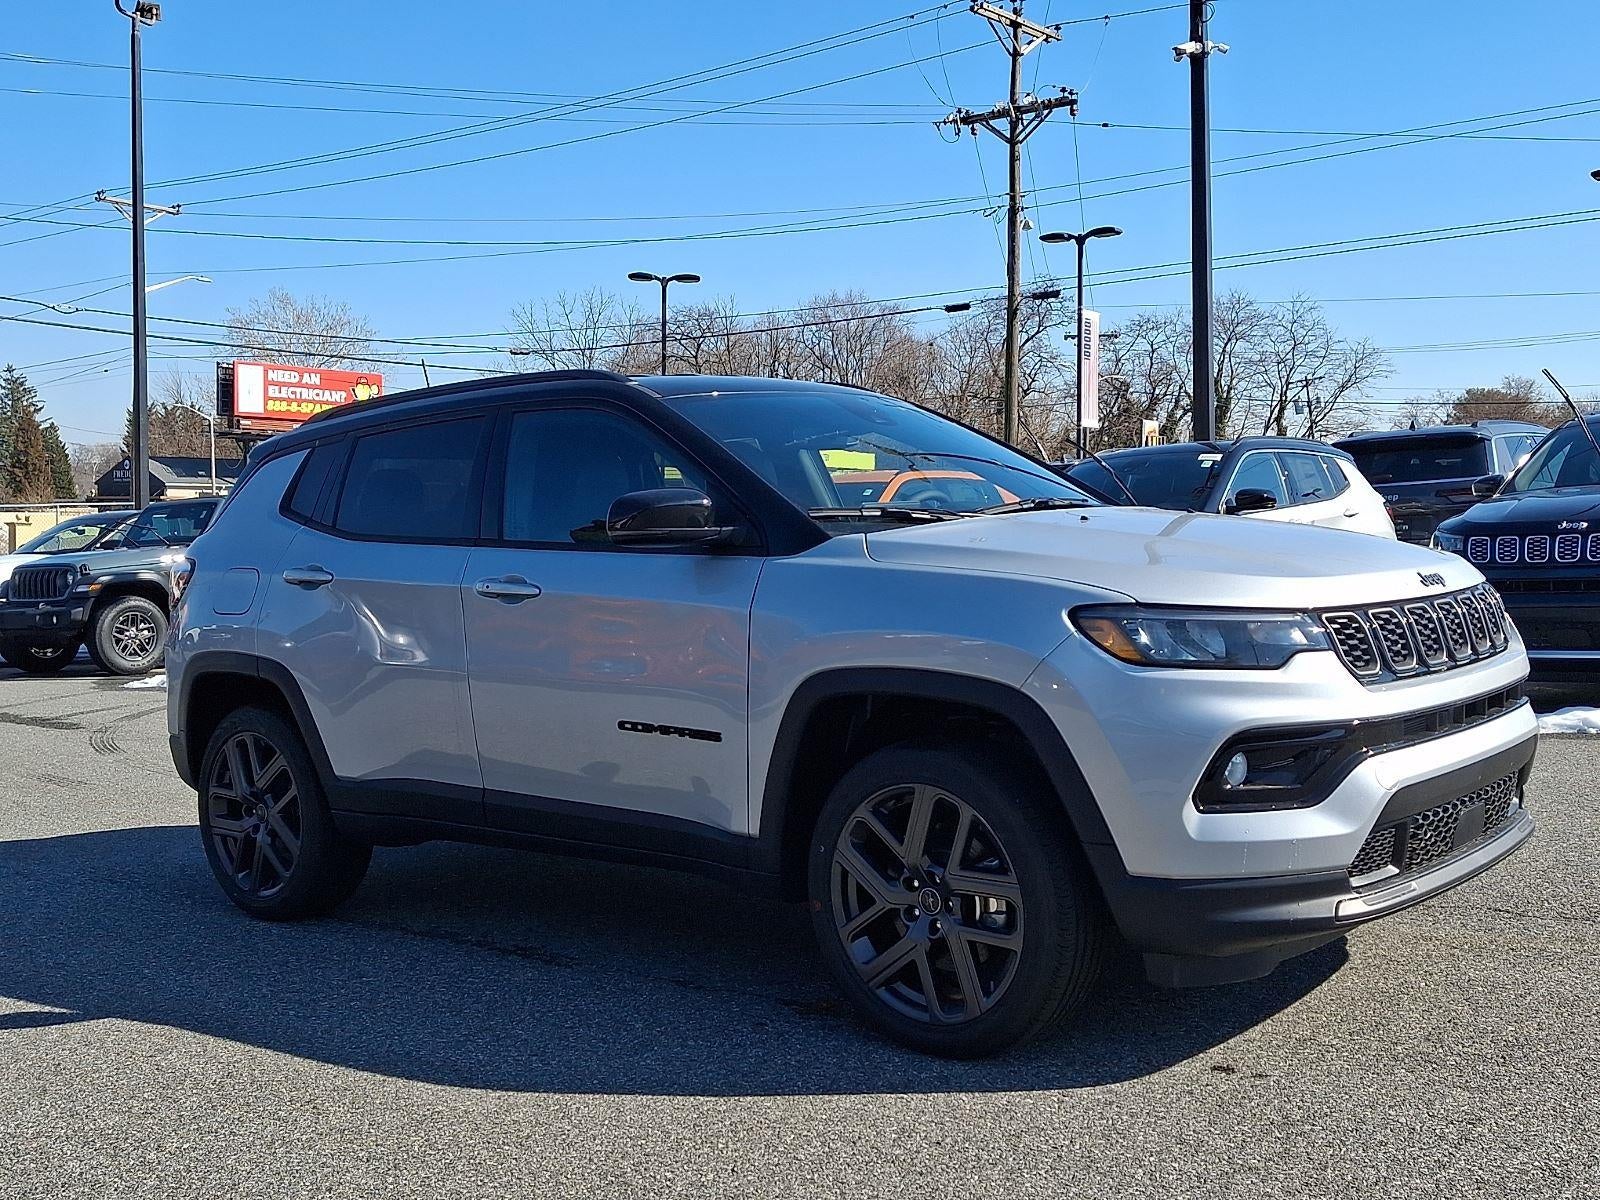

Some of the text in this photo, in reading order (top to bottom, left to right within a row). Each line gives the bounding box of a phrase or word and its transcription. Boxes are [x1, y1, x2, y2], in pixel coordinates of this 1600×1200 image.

[267, 369, 321, 385] NEED AN
[267, 385, 347, 403] ELECTRICIAN?
[113, 469, 131, 478] FRED
[1557, 520, 1588, 530] Jeep
[1416, 571, 1446, 588] Jeep
[617, 719, 722, 743] COMPASS
